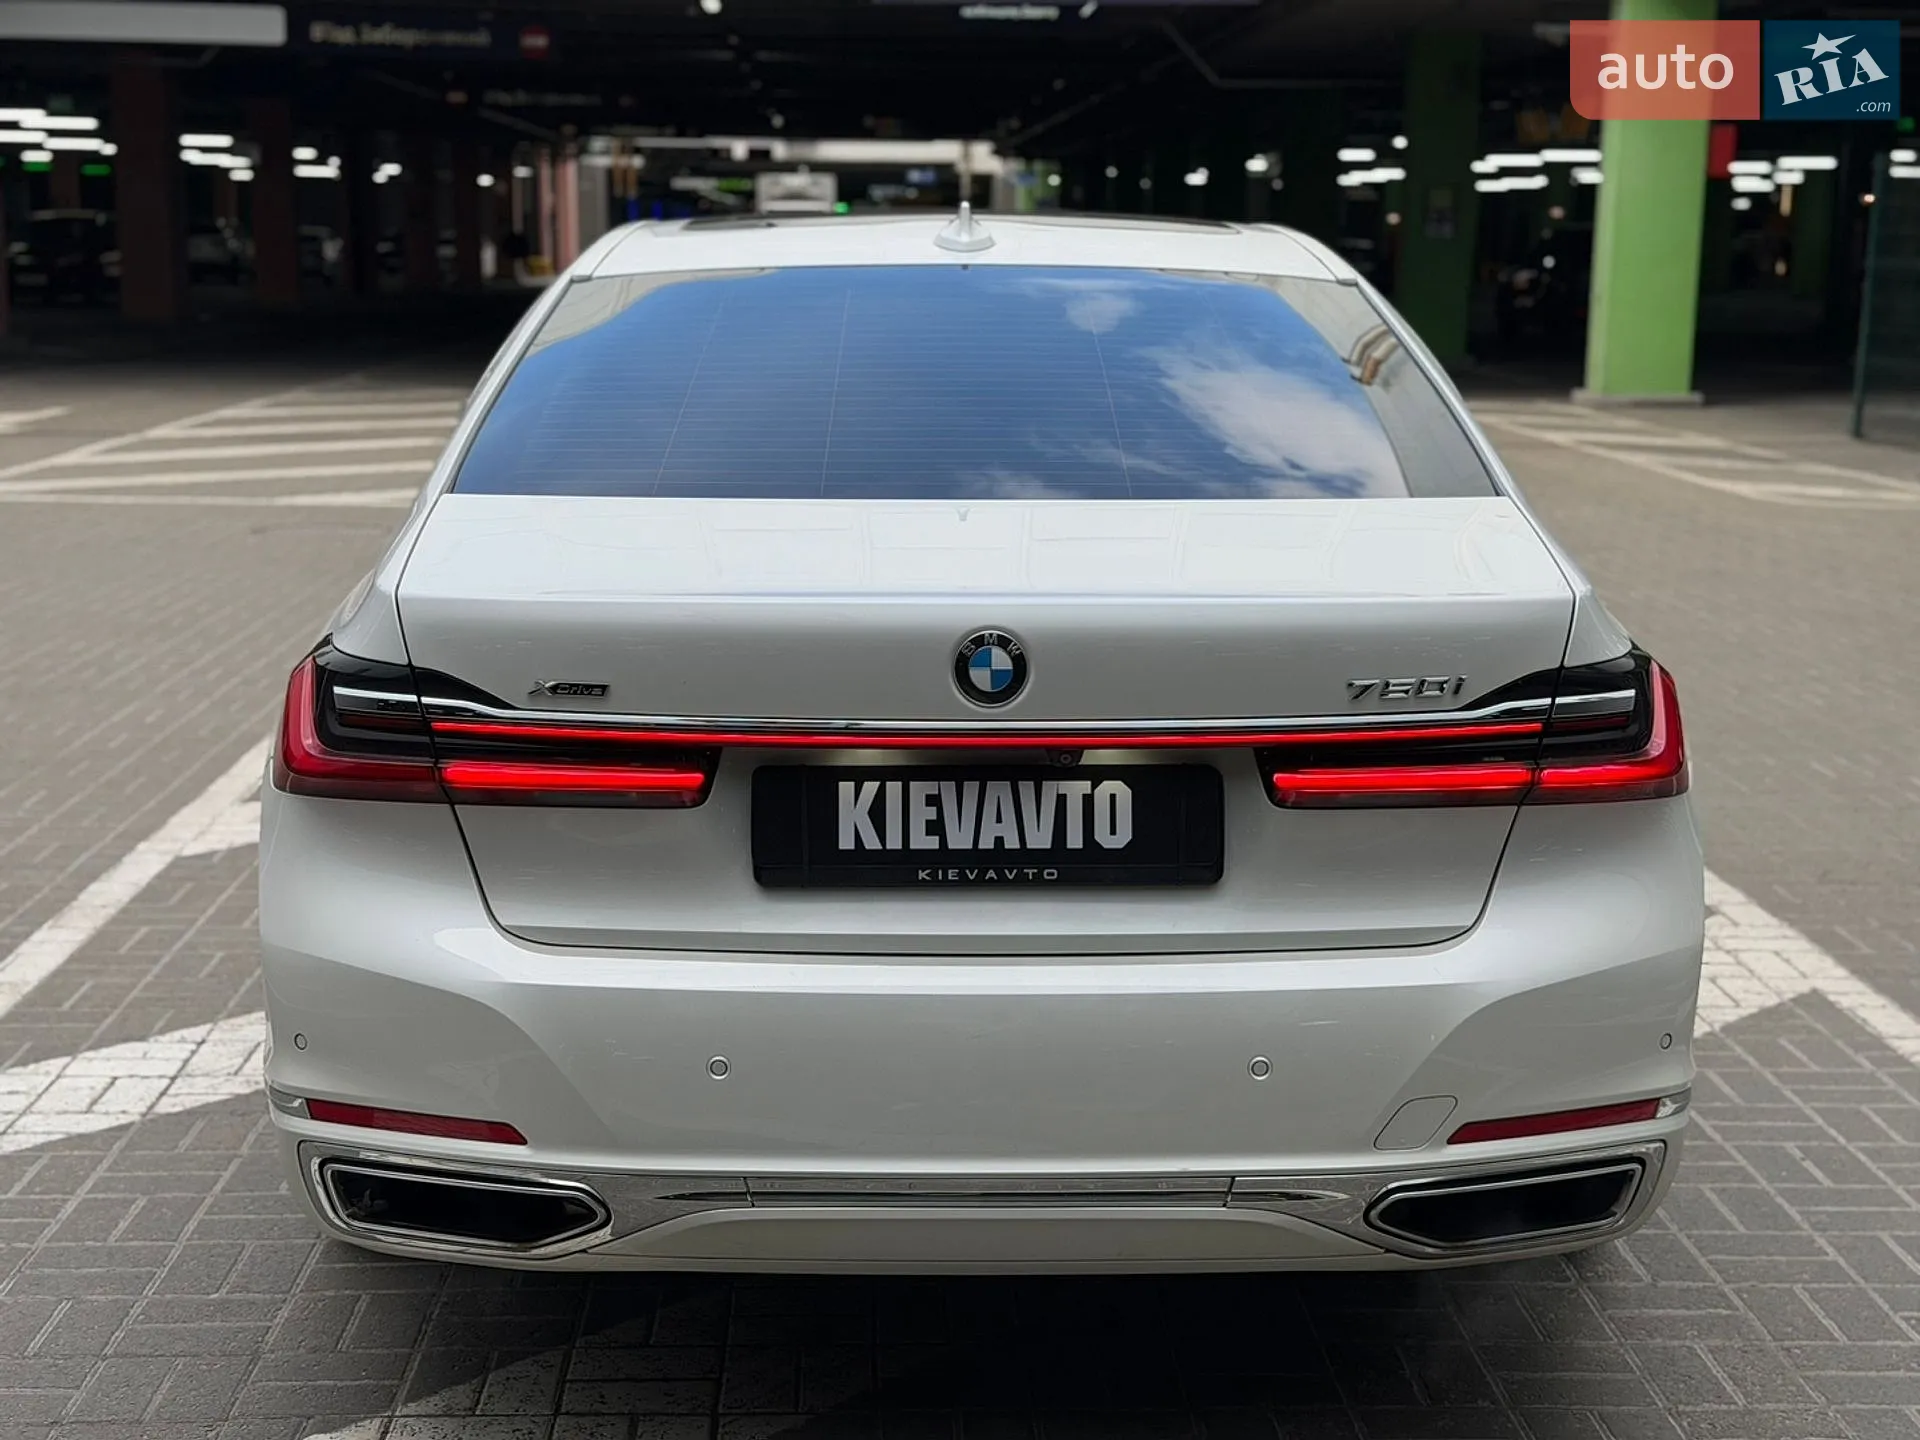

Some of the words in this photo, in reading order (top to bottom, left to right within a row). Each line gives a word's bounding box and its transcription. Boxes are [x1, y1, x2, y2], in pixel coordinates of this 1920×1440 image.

[960, 632, 1022, 658] BMW
[1345, 674, 1468, 700] 750i
[838, 780, 1133, 850] KIEVAVTO
[917, 868, 1059, 881] KIEVAVTO
